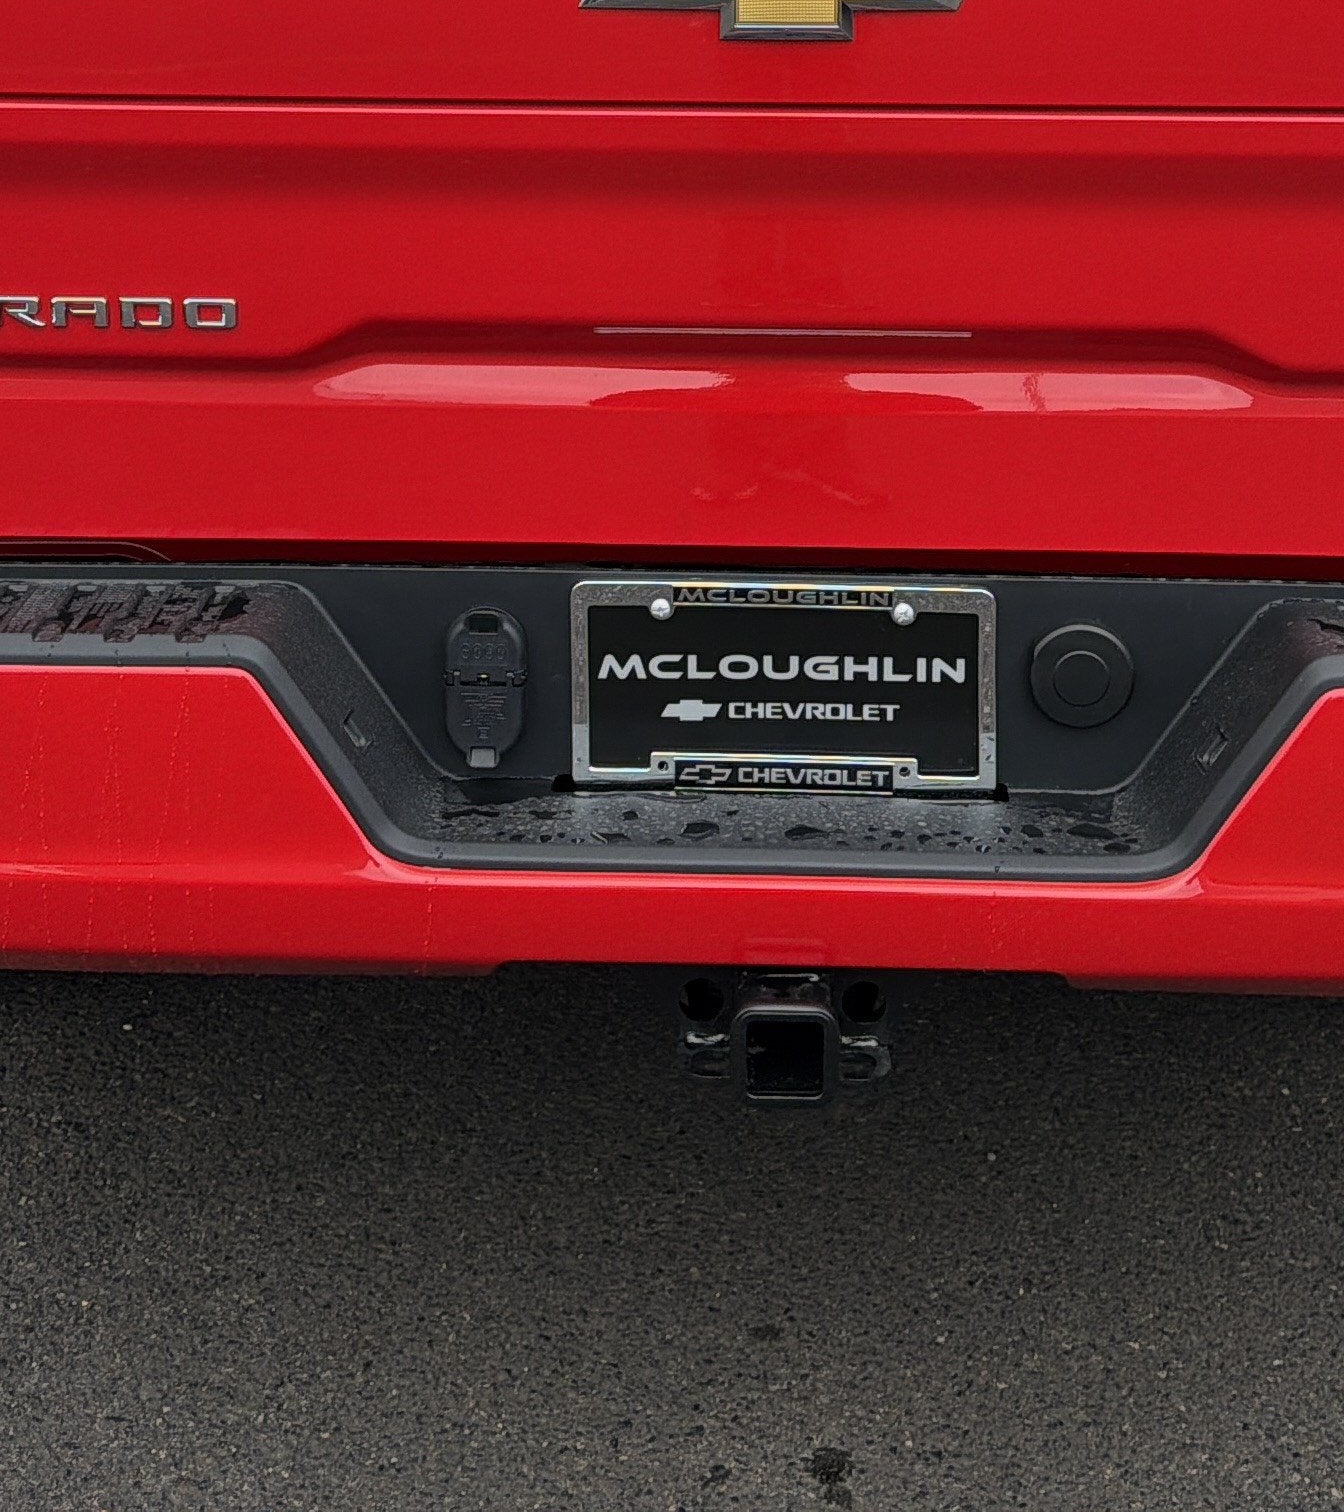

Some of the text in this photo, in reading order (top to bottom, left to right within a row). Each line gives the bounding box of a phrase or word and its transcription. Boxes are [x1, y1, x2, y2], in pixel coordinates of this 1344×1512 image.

[677, 588, 890, 606] MCLOUGHLIN
[598, 653, 967, 684] MCLOUGHLIN
[727, 701, 901, 722] CHEVROLET
[737, 766, 890, 788] CHEVROLET
